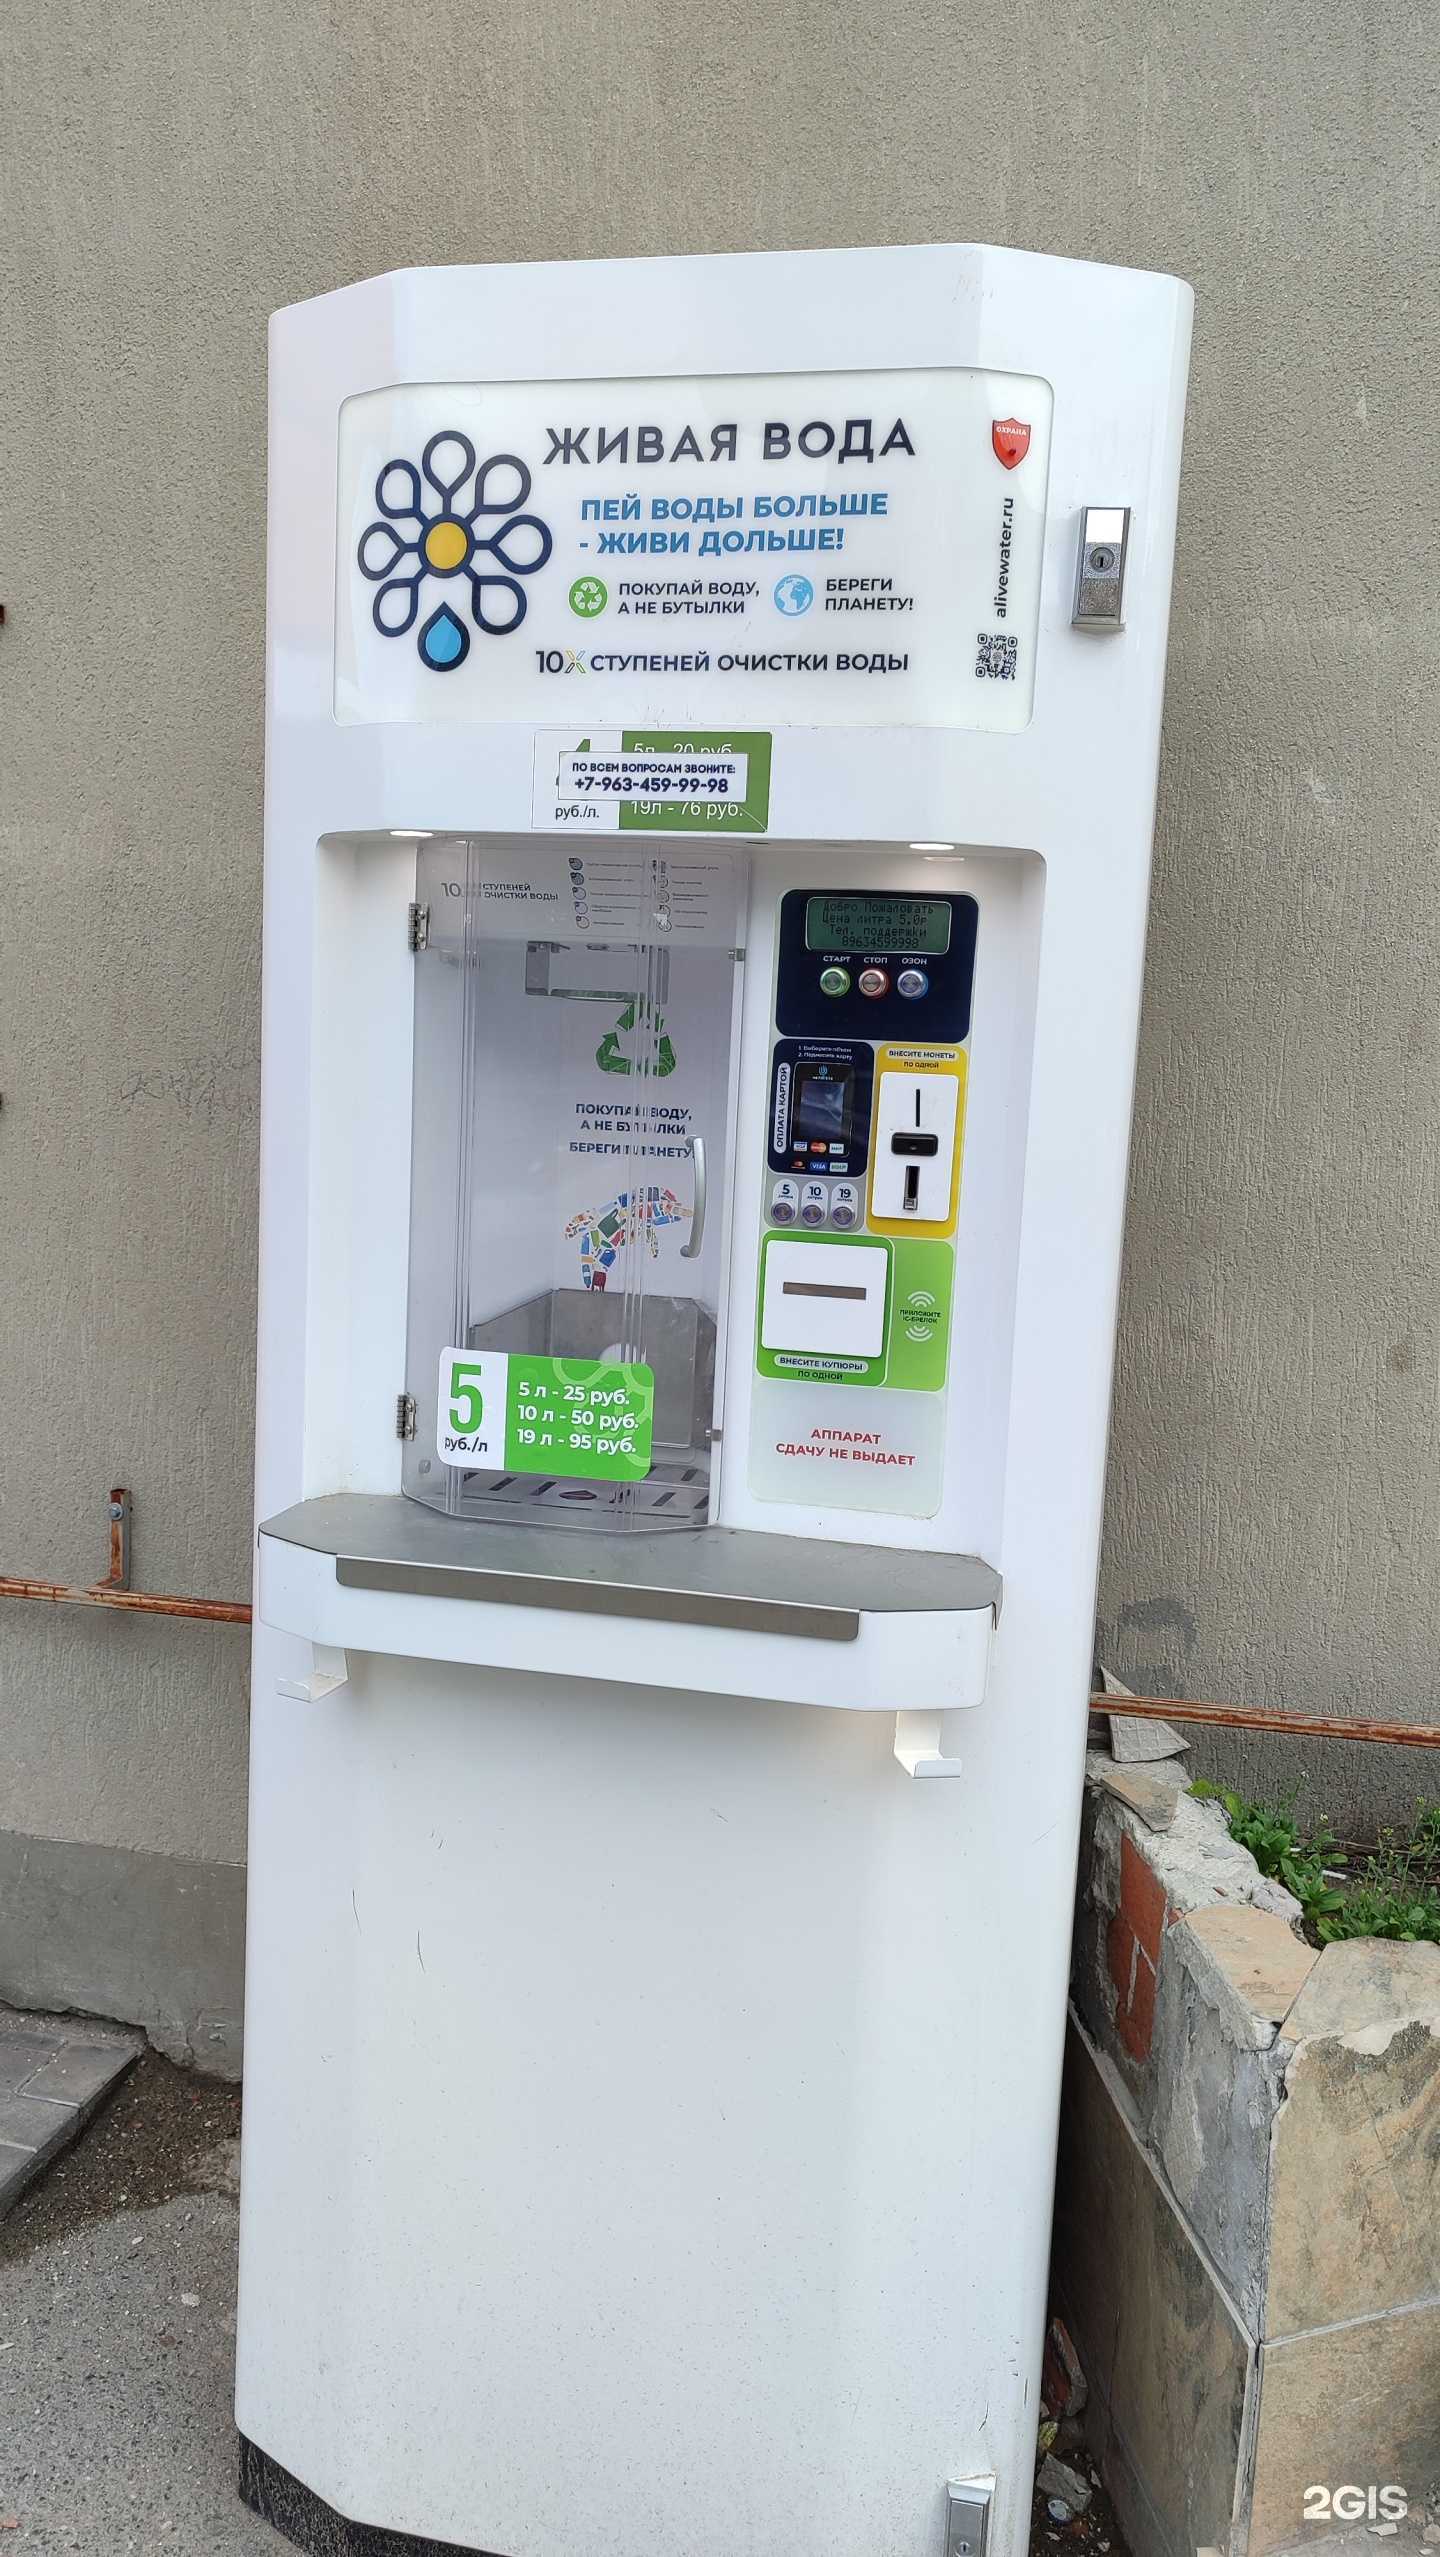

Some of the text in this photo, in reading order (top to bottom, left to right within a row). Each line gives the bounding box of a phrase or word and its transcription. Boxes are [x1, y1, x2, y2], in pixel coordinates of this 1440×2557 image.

[543, 418, 916, 464] ЖИВАЯ ВОДА
[581, 493, 888, 523] ПЕЙ ВОДЫ БОЛЬШЕ
[597, 532, 689, 554] ЖИВИ
[698, 528, 844, 556] ДОЛЬШЕ!
[994, 497, 1014, 619] alivewater.ru
[618, 579, 760, 598] ПОКУПАЙ ВОДУ,
[826, 578, 893, 592] БЕРЕГИ
[618, 601, 745, 614] А НЕ БУТЫЛКИ
[825, 598, 914, 611] ПЛАНЕТУ!
[590, 651, 710, 672] СТУПЕНЕЙ
[717, 654, 828, 671] ОЧИСТКИ
[836, 654, 909, 673] ВОДЫ
[572, 763, 736, 774] ПО ВСЕМ ВОПРОСАМ ЗВОНИТЕ:
[574, 776, 729, 793] +7-963-459-99-98
[555, 805, 600, 820] руб./л.
[707, 801, 743, 820] руб.
[482, 883, 531, 891] СТУПЕНЕЙ
[484, 892, 559, 901] ОЧИСТКИ ВОДЫ
[824, 901, 934, 914] Добро Пожаловать
[823, 911, 850, 924] Цена
[823, 955, 851, 963] СТАРТ
[864, 956, 888, 964] СТОП
[901, 957, 928, 965] ОЗОН
[889, 1050, 955, 1059] ВНЕСИТЕ МОНЕТЫ
[915, 1061, 939, 1069] ОДНОЙ
[776, 1066, 788, 1147] ОПЛАТА КАРТОЙ
[580, 1120, 590, 1130] А
[594, 1120, 612, 1131] НЕ
[569, 1142, 620, 1155] БЕРЕГИ
[782, 1184, 790, 1195] 5
[809, 1186, 821, 1196] 10
[839, 1188, 851, 1199] 19
[780, 1357, 863, 1371] ВНЕСИТЕ КУПЮРЫ
[797, 1370, 843, 1380] ПО ОДНОЙ
[449, 1362, 483, 1434] 5
[518, 1381, 530, 1397] 5
[534, 1386, 547, 1398] л
[563, 1385, 585, 1401] 25
[590, 1388, 630, 1406] руб.
[517, 1405, 537, 1421] 10
[541, 1410, 554, 1422] л
[571, 1409, 594, 1426] 50
[599, 1412, 639, 1431] руб.
[517, 1428, 535, 1445] 19
[539, 1434, 552, 1446] л
[569, 1434, 592, 1450] 95
[597, 1437, 636, 1455] руб.
[811, 1429, 881, 1445] АППАРАТ
[444, 1436, 488, 1453] руб./л
[776, 1443, 916, 1466] СДАЧУ НЕ ВЫДАЕТ
